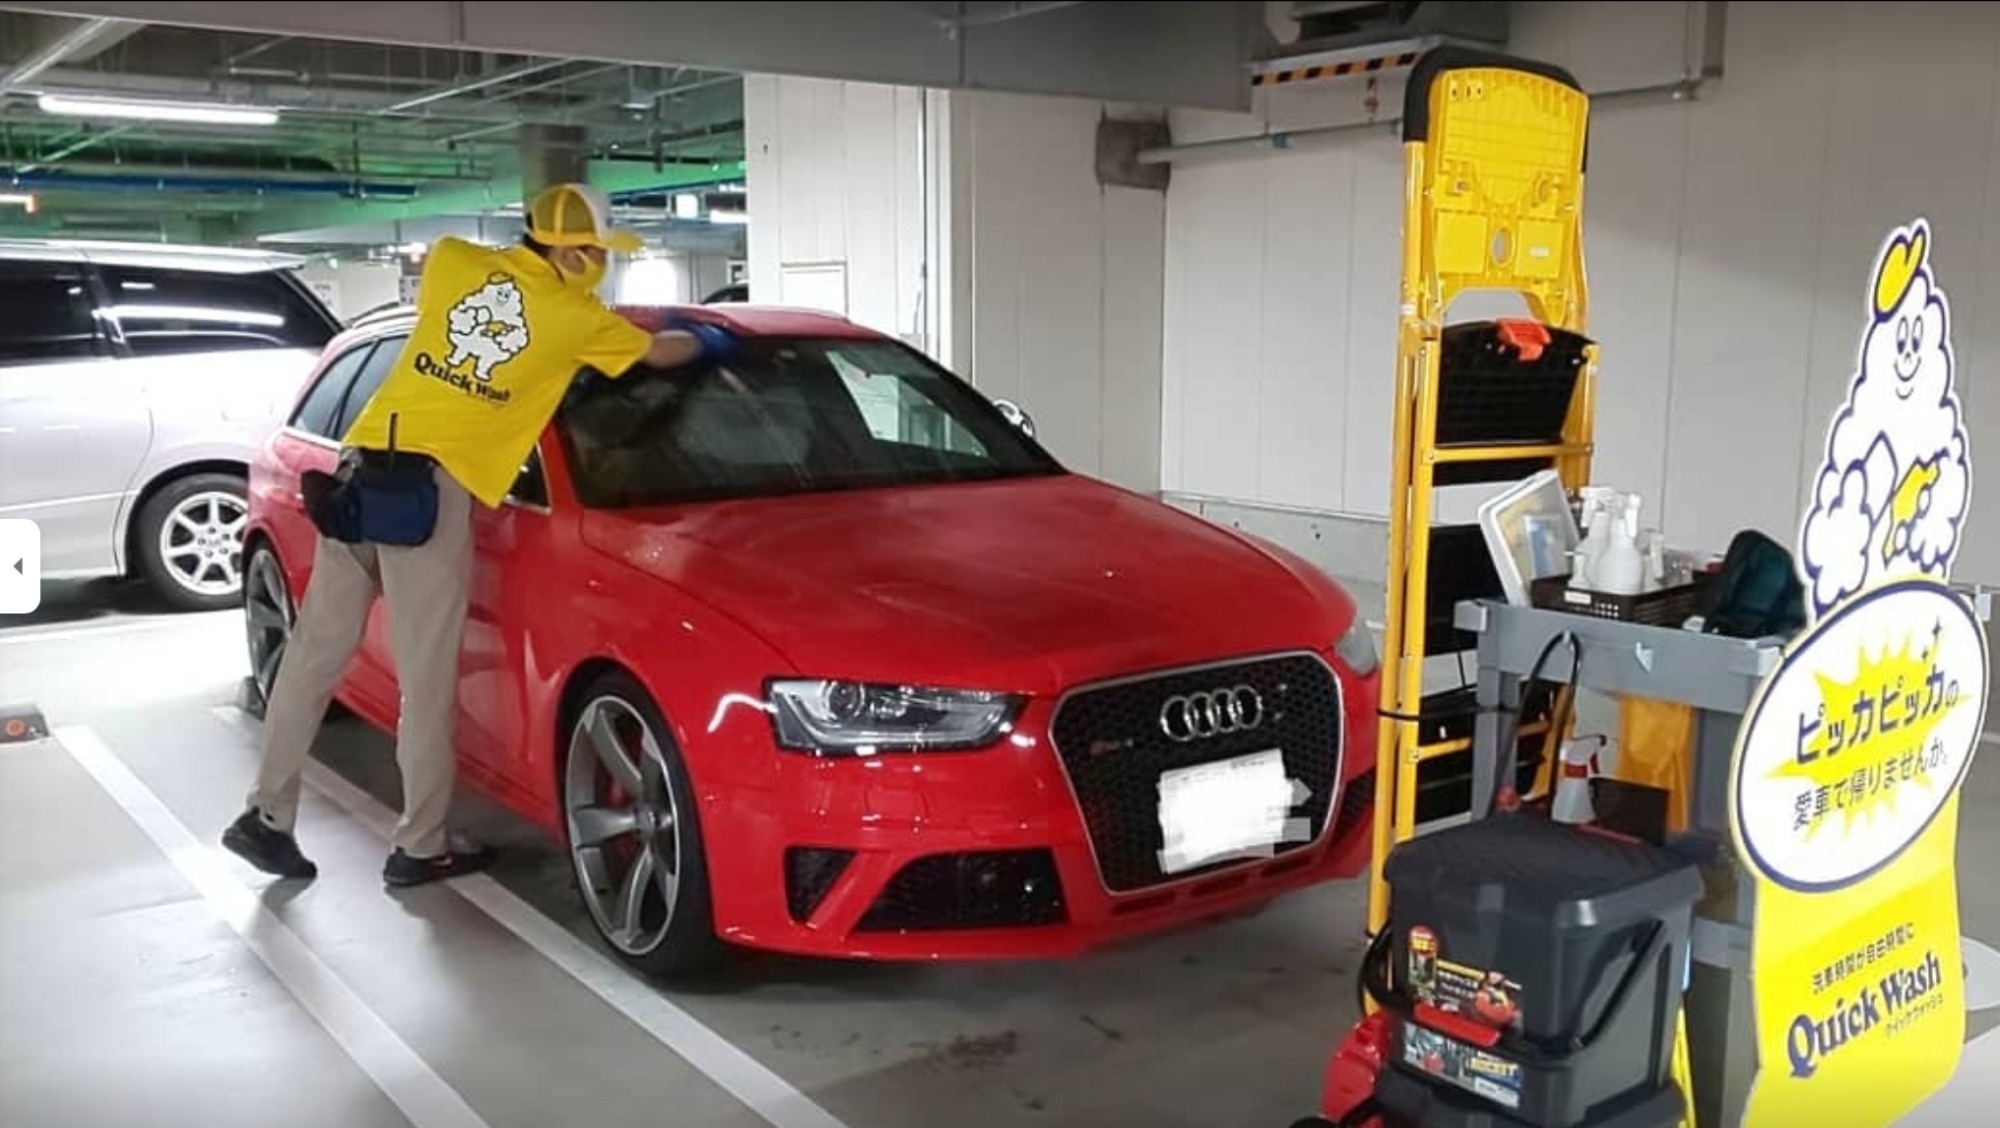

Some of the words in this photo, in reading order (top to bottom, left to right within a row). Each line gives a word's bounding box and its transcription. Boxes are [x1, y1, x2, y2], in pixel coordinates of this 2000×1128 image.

[414, 352, 472, 394] Quick
[1797, 664, 1960, 765] ピッカピッカの
[1787, 985, 1880, 1078] Quick
[1880, 950, 1942, 1014] Wash
